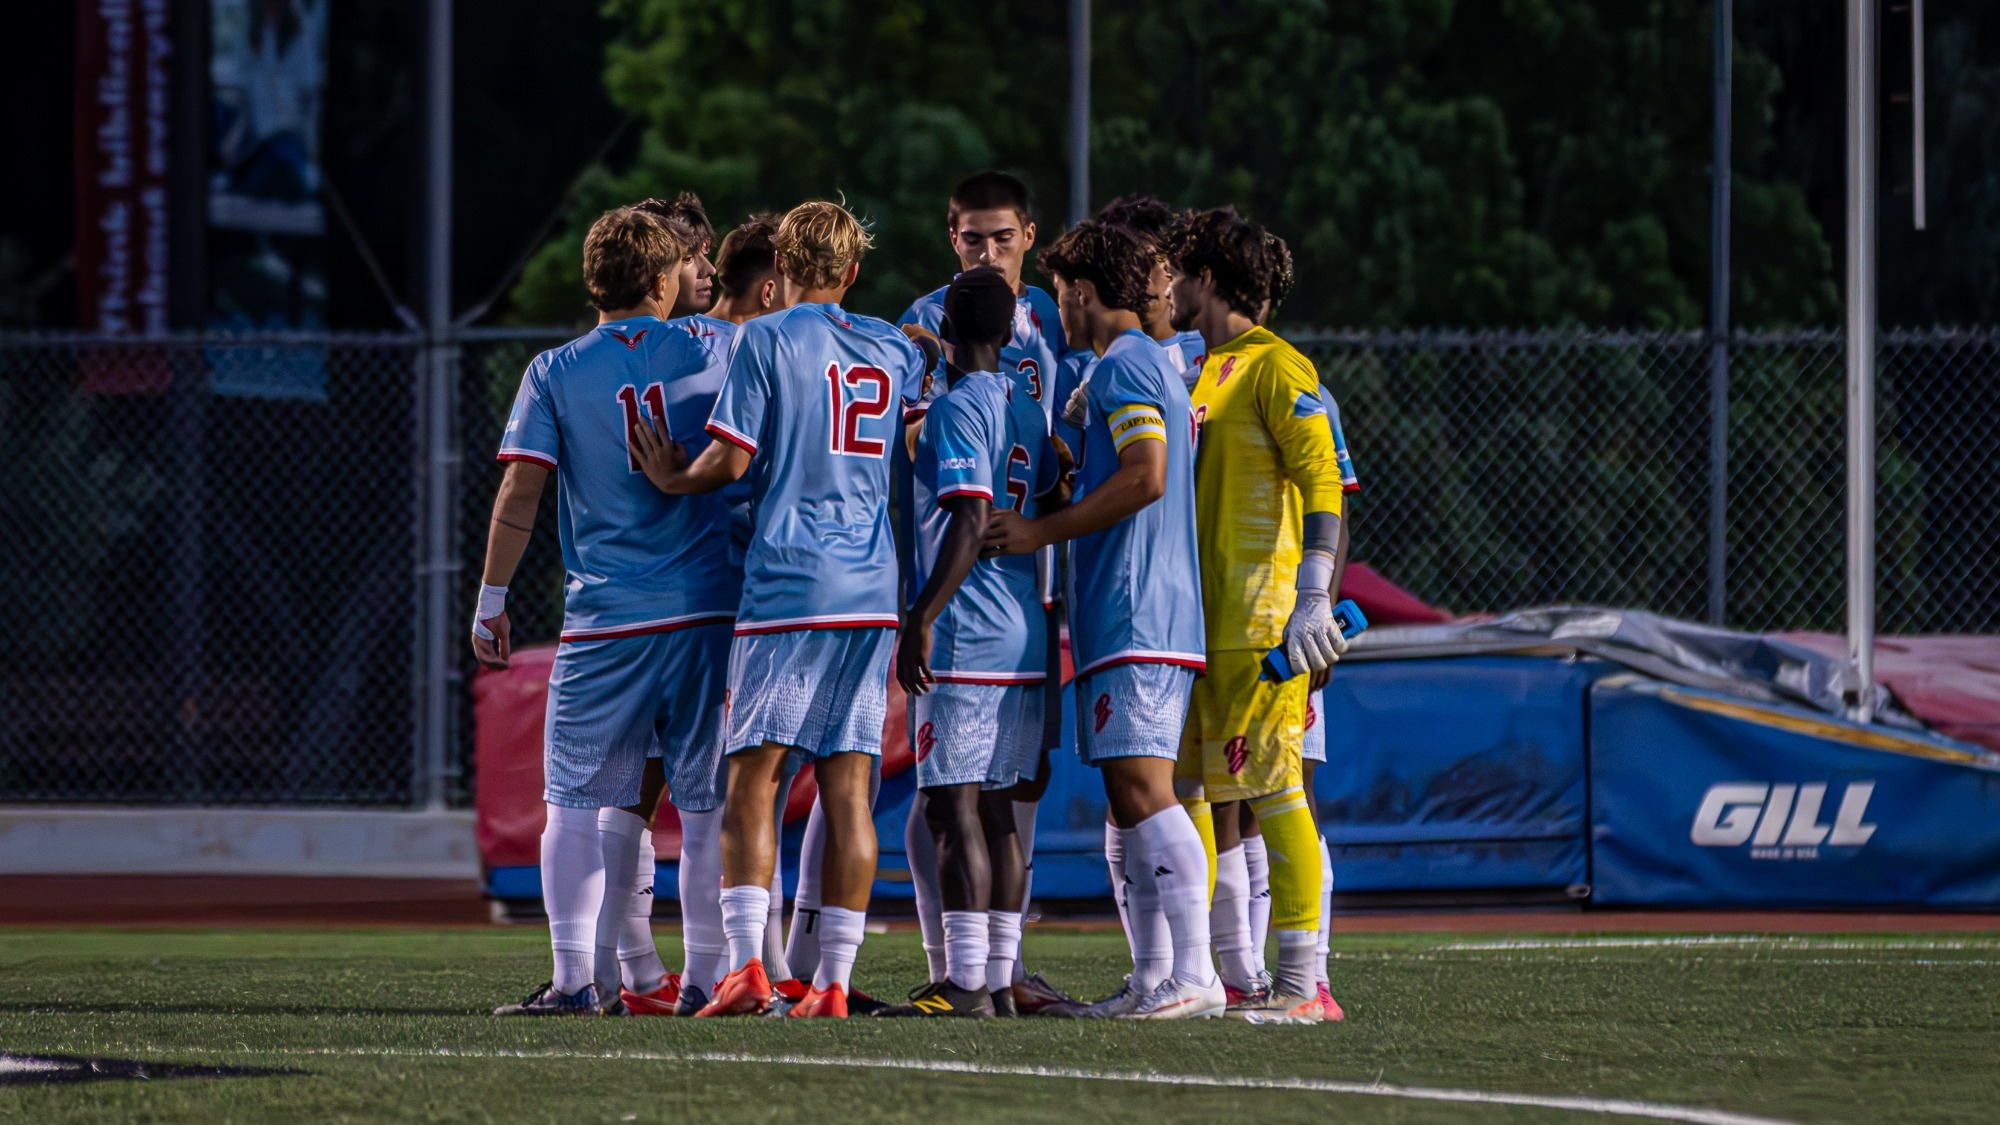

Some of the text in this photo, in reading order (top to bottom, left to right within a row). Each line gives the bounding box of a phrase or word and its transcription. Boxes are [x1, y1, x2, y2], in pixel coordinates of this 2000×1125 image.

[825, 360, 893, 458] 12
[1016, 357, 1043, 402] 3
[616, 381, 672, 474] 11
[939, 457, 976, 471] NCAA
[1690, 781, 1878, 847] GILL
